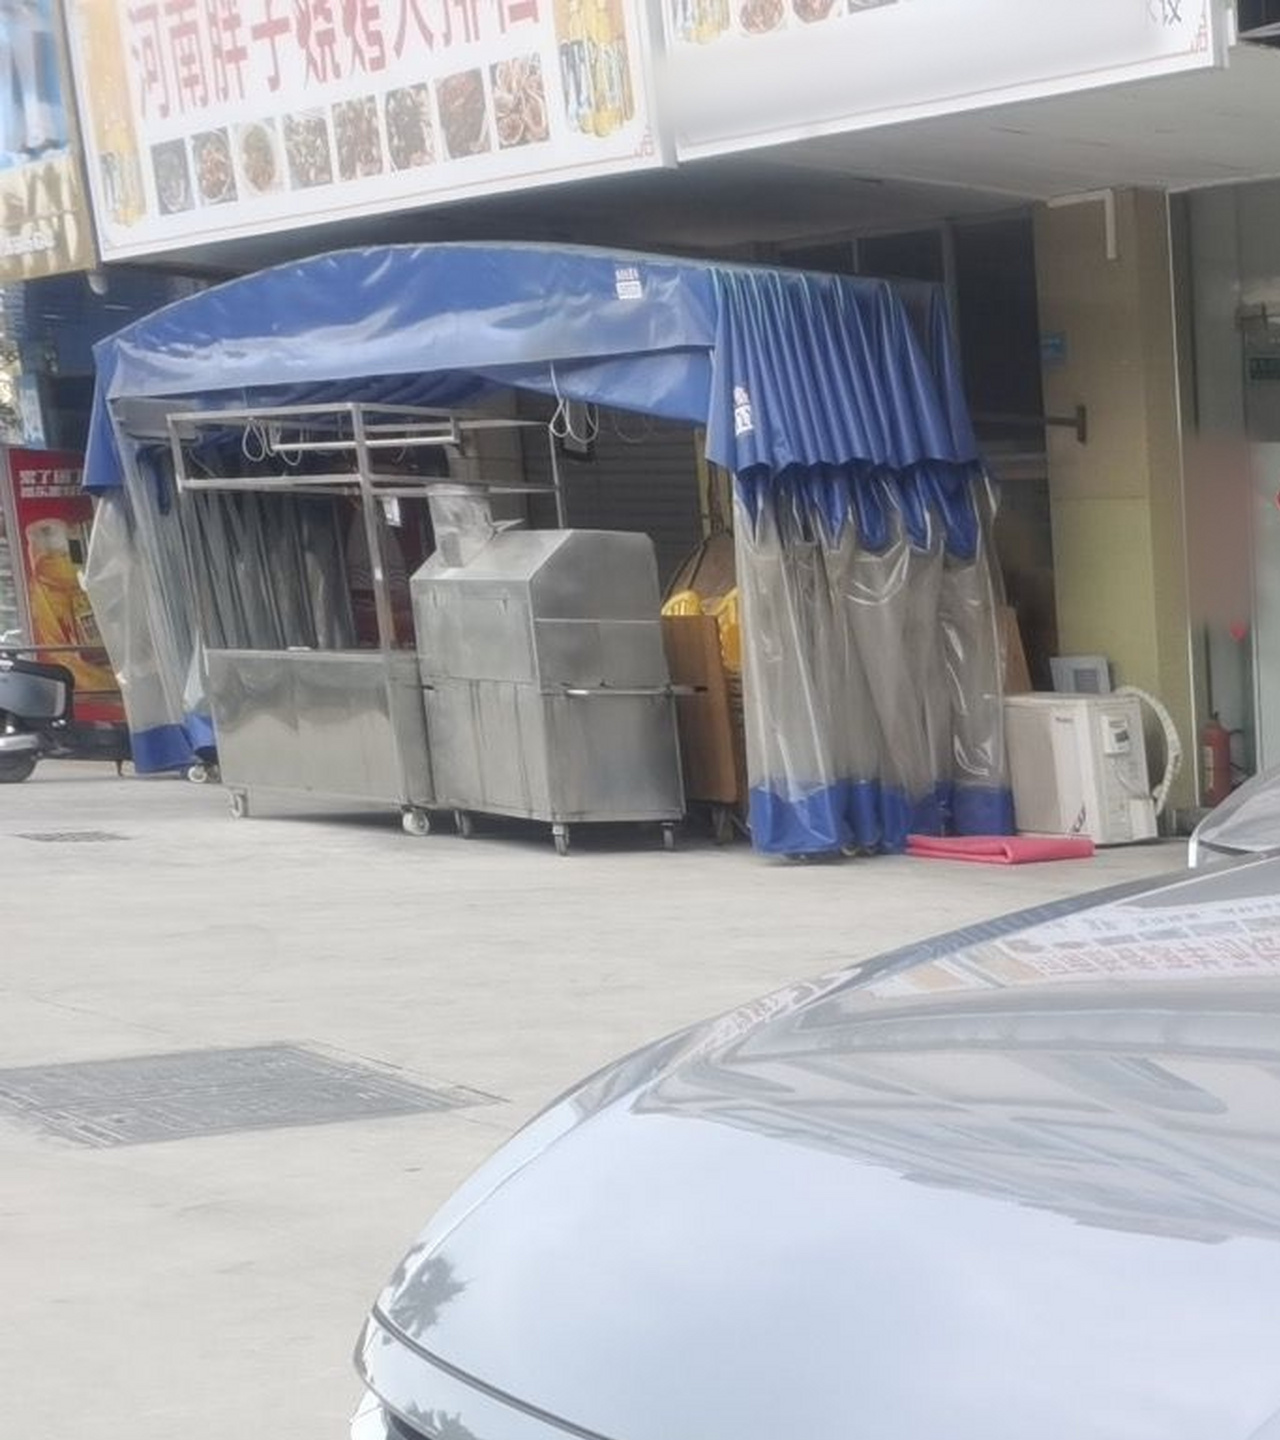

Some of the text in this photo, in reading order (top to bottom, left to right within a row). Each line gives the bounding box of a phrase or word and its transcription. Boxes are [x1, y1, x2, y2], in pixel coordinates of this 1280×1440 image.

[129, 0, 541, 118] 河南胖子烧烤大
